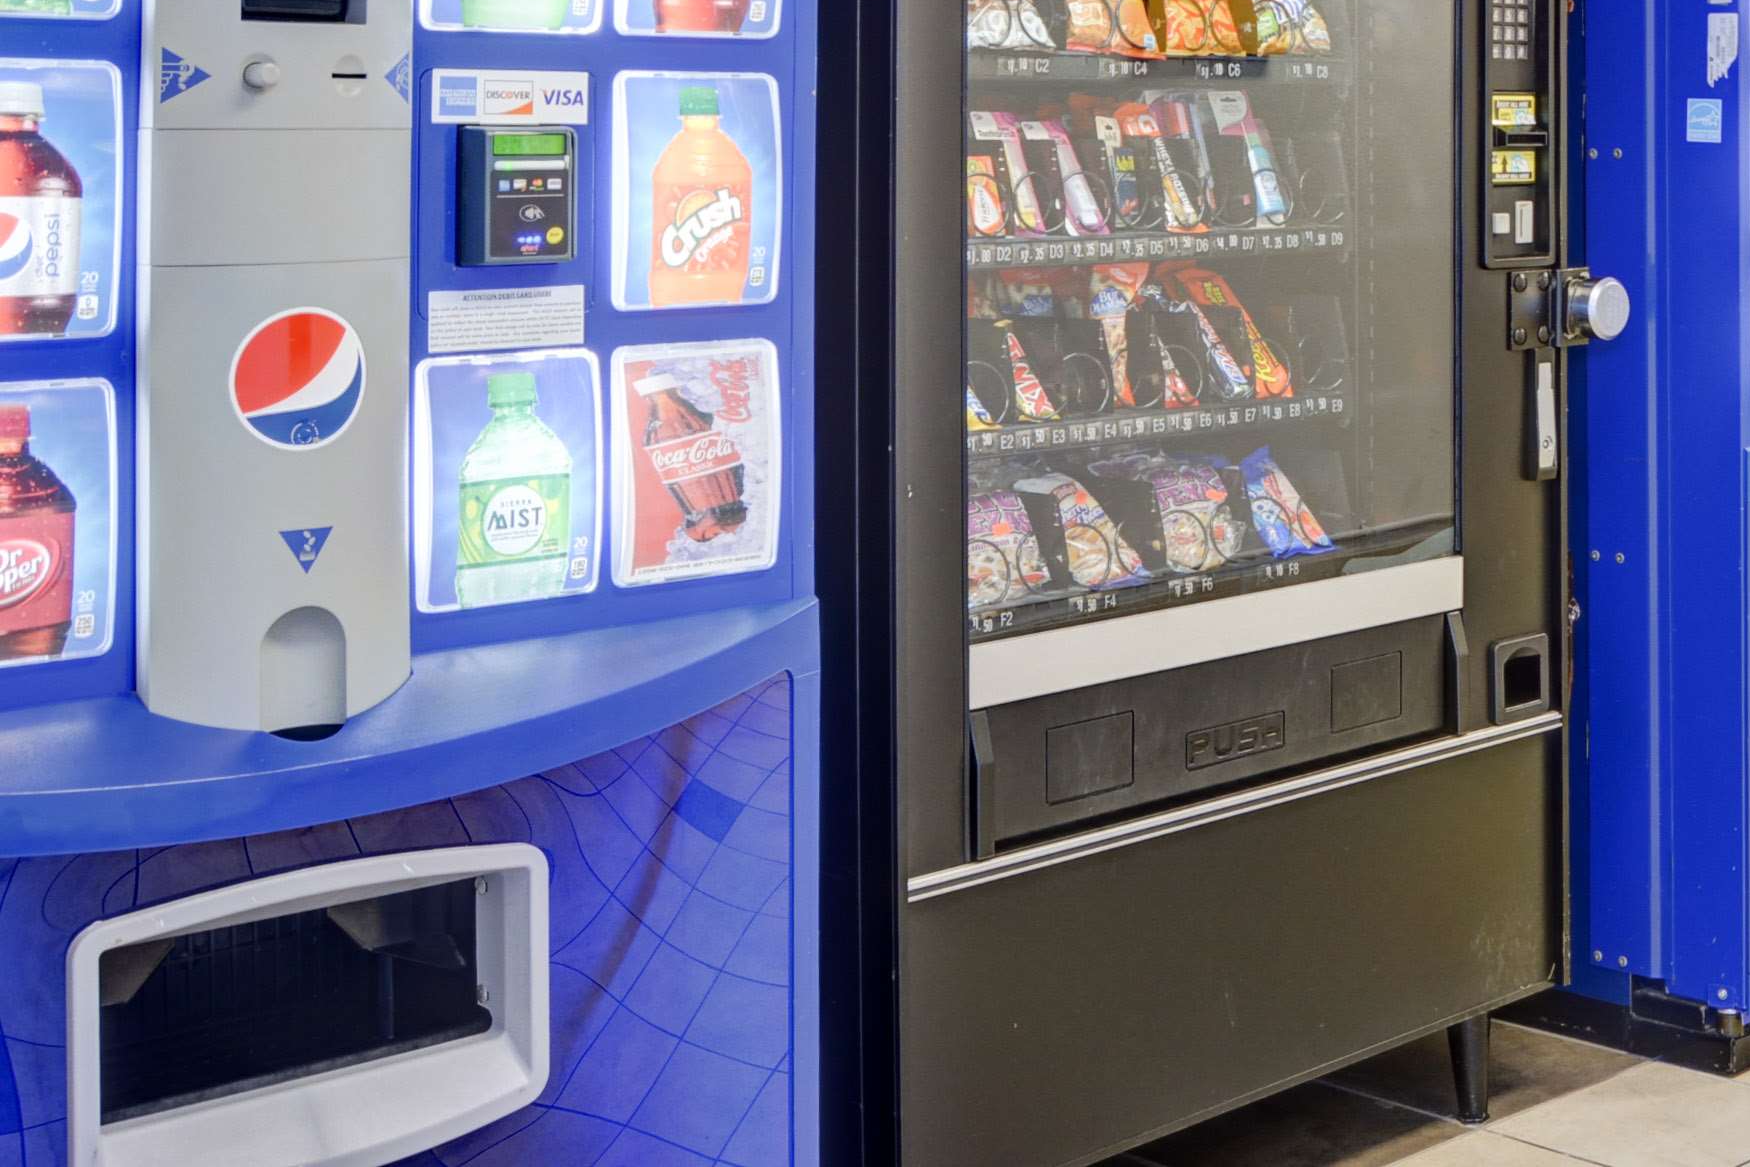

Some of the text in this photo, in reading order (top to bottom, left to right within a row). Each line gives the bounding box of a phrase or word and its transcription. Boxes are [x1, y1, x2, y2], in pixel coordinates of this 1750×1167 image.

[486, 90, 531, 100] DISCOVER
[542, 88, 584, 106] VISA
[661, 187, 743, 268] Crush
[44, 213, 62, 278] pepsi
[651, 435, 736, 470] Coca-Cola
[486, 506, 542, 531] MIST
[1188, 719, 1284, 765] PUSH
